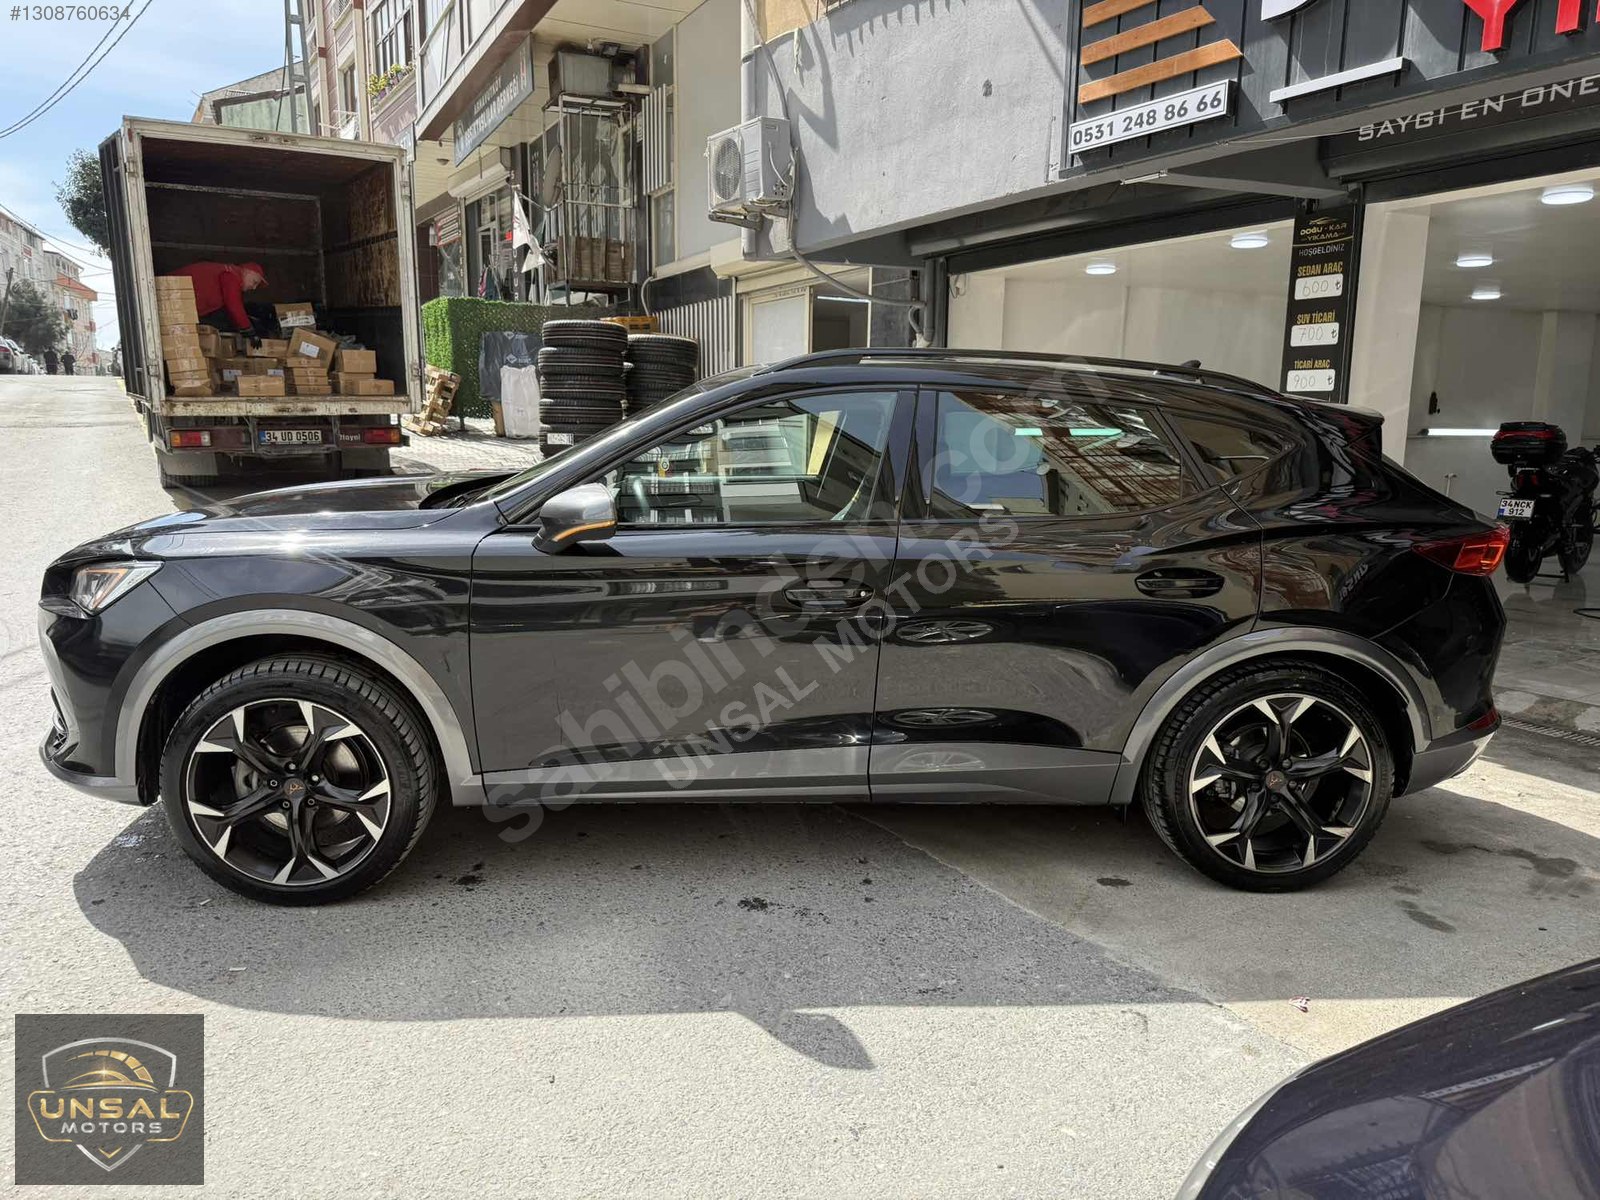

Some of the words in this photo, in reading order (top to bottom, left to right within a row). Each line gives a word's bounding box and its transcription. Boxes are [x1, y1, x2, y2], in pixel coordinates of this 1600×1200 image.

[1073, 122, 1114, 146] 0531
[1122, 109, 1157, 133] 248
[1164, 100, 1188, 122] 86
[1196, 90, 1222, 113] 66
[1357, 109, 1445, 142] SAYGI
[1460, 94, 1505, 120] EN
[1329, 222, 1347, 231] KAR
[1297, 264, 1322, 277] SEDAN
[1322, 261, 1344, 275] ARAÇ
[1302, 280, 1329, 297] 600
[1296, 313, 1311, 325] SUV
[1311, 310, 1336, 324] TİCARİ
[1299, 326, 1324, 341] 700
[1294, 358, 1313, 369] TİCARİ
[1313, 359, 1331, 369] ARAÇ
[1293, 374, 1316, 389] 900
[266, 431, 278, 442] 34
[281, 431, 293, 442] UD
[295, 431, 320, 441] 0506
[1508, 508, 1525, 516] 912
